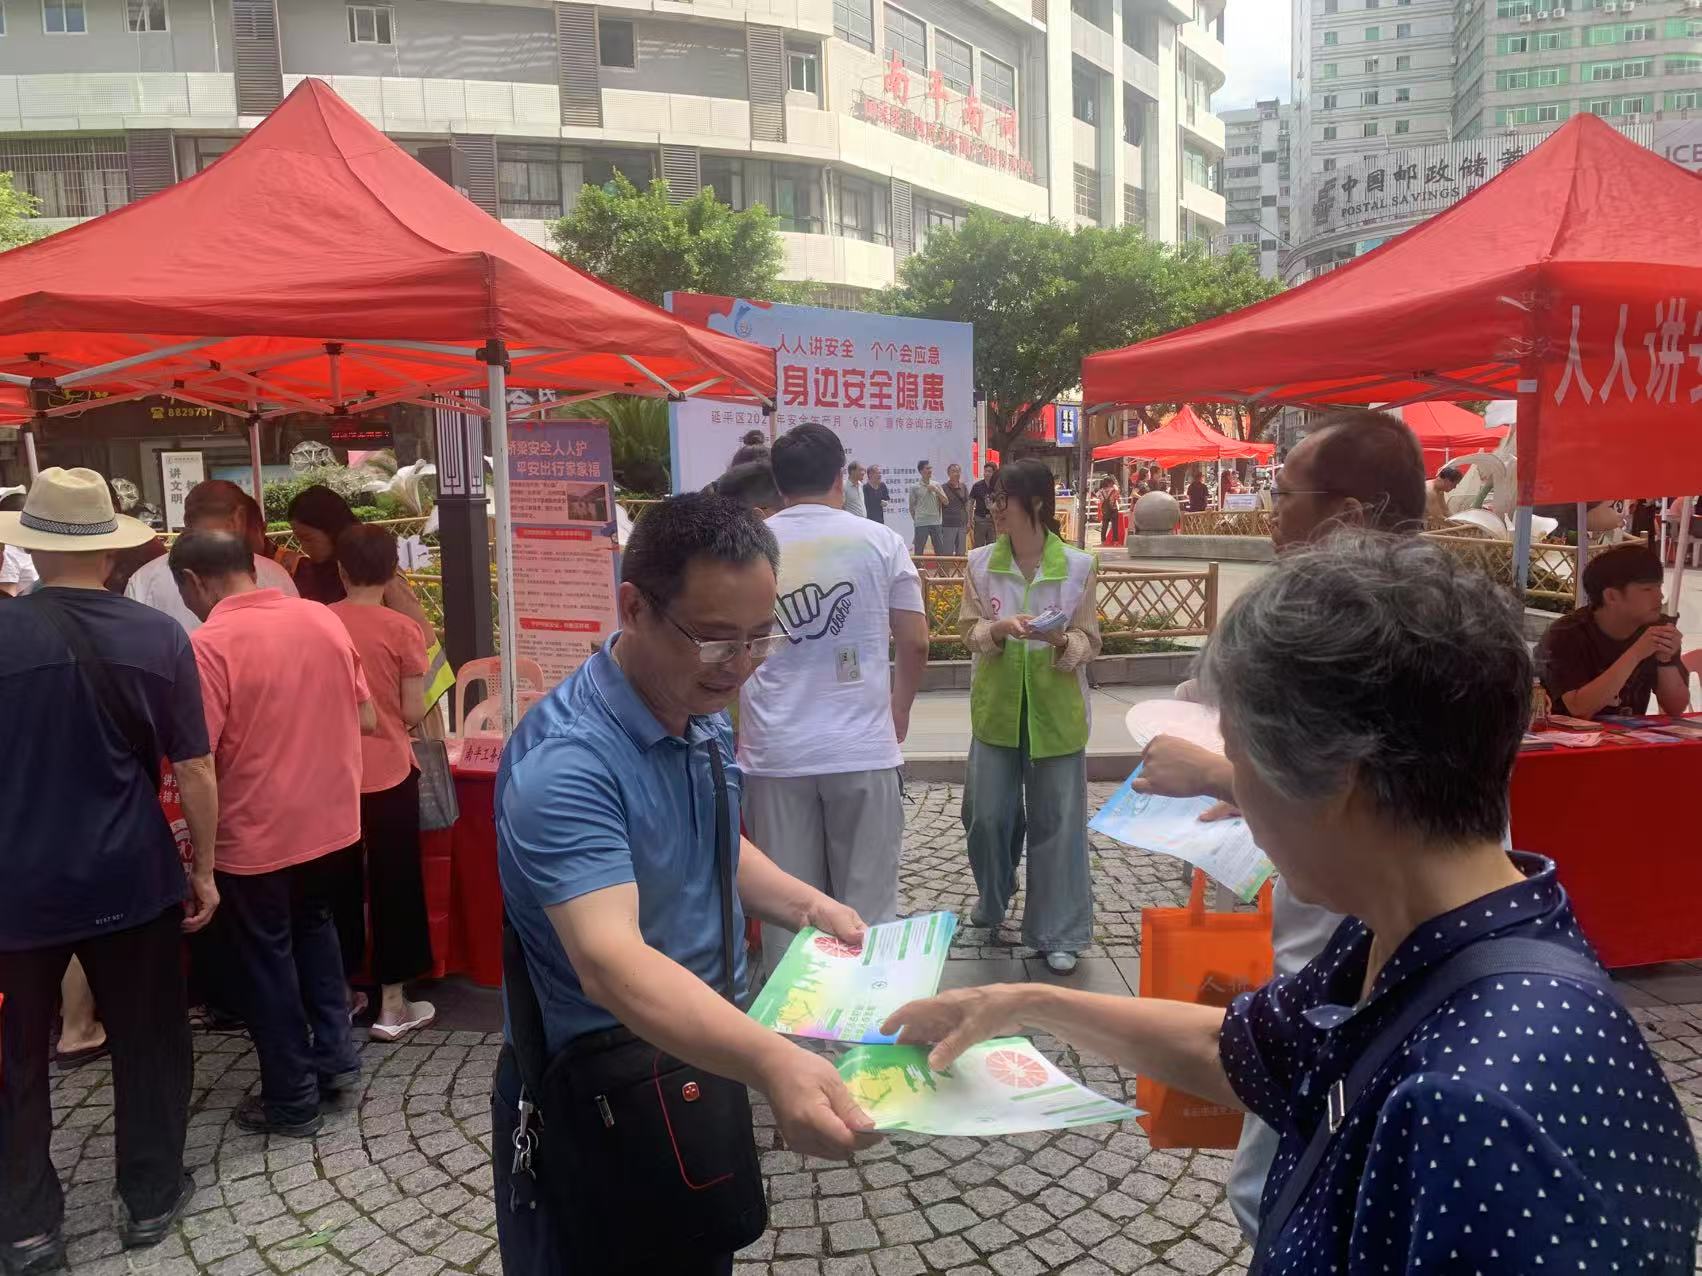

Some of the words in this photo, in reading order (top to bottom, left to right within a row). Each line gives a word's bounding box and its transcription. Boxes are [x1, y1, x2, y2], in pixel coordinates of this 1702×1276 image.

[1341, 198, 1388, 218] POSTAL
[1391, 186, 1460, 207] SAVINGS
[777, 334, 854, 358] 人人讲安全
[871, 342, 940, 365] 个个会应急
[783, 365, 945, 411] 身边安全隐患
[169, 468, 183, 504] 讲文明
[830, 598, 852, 636] aloha
